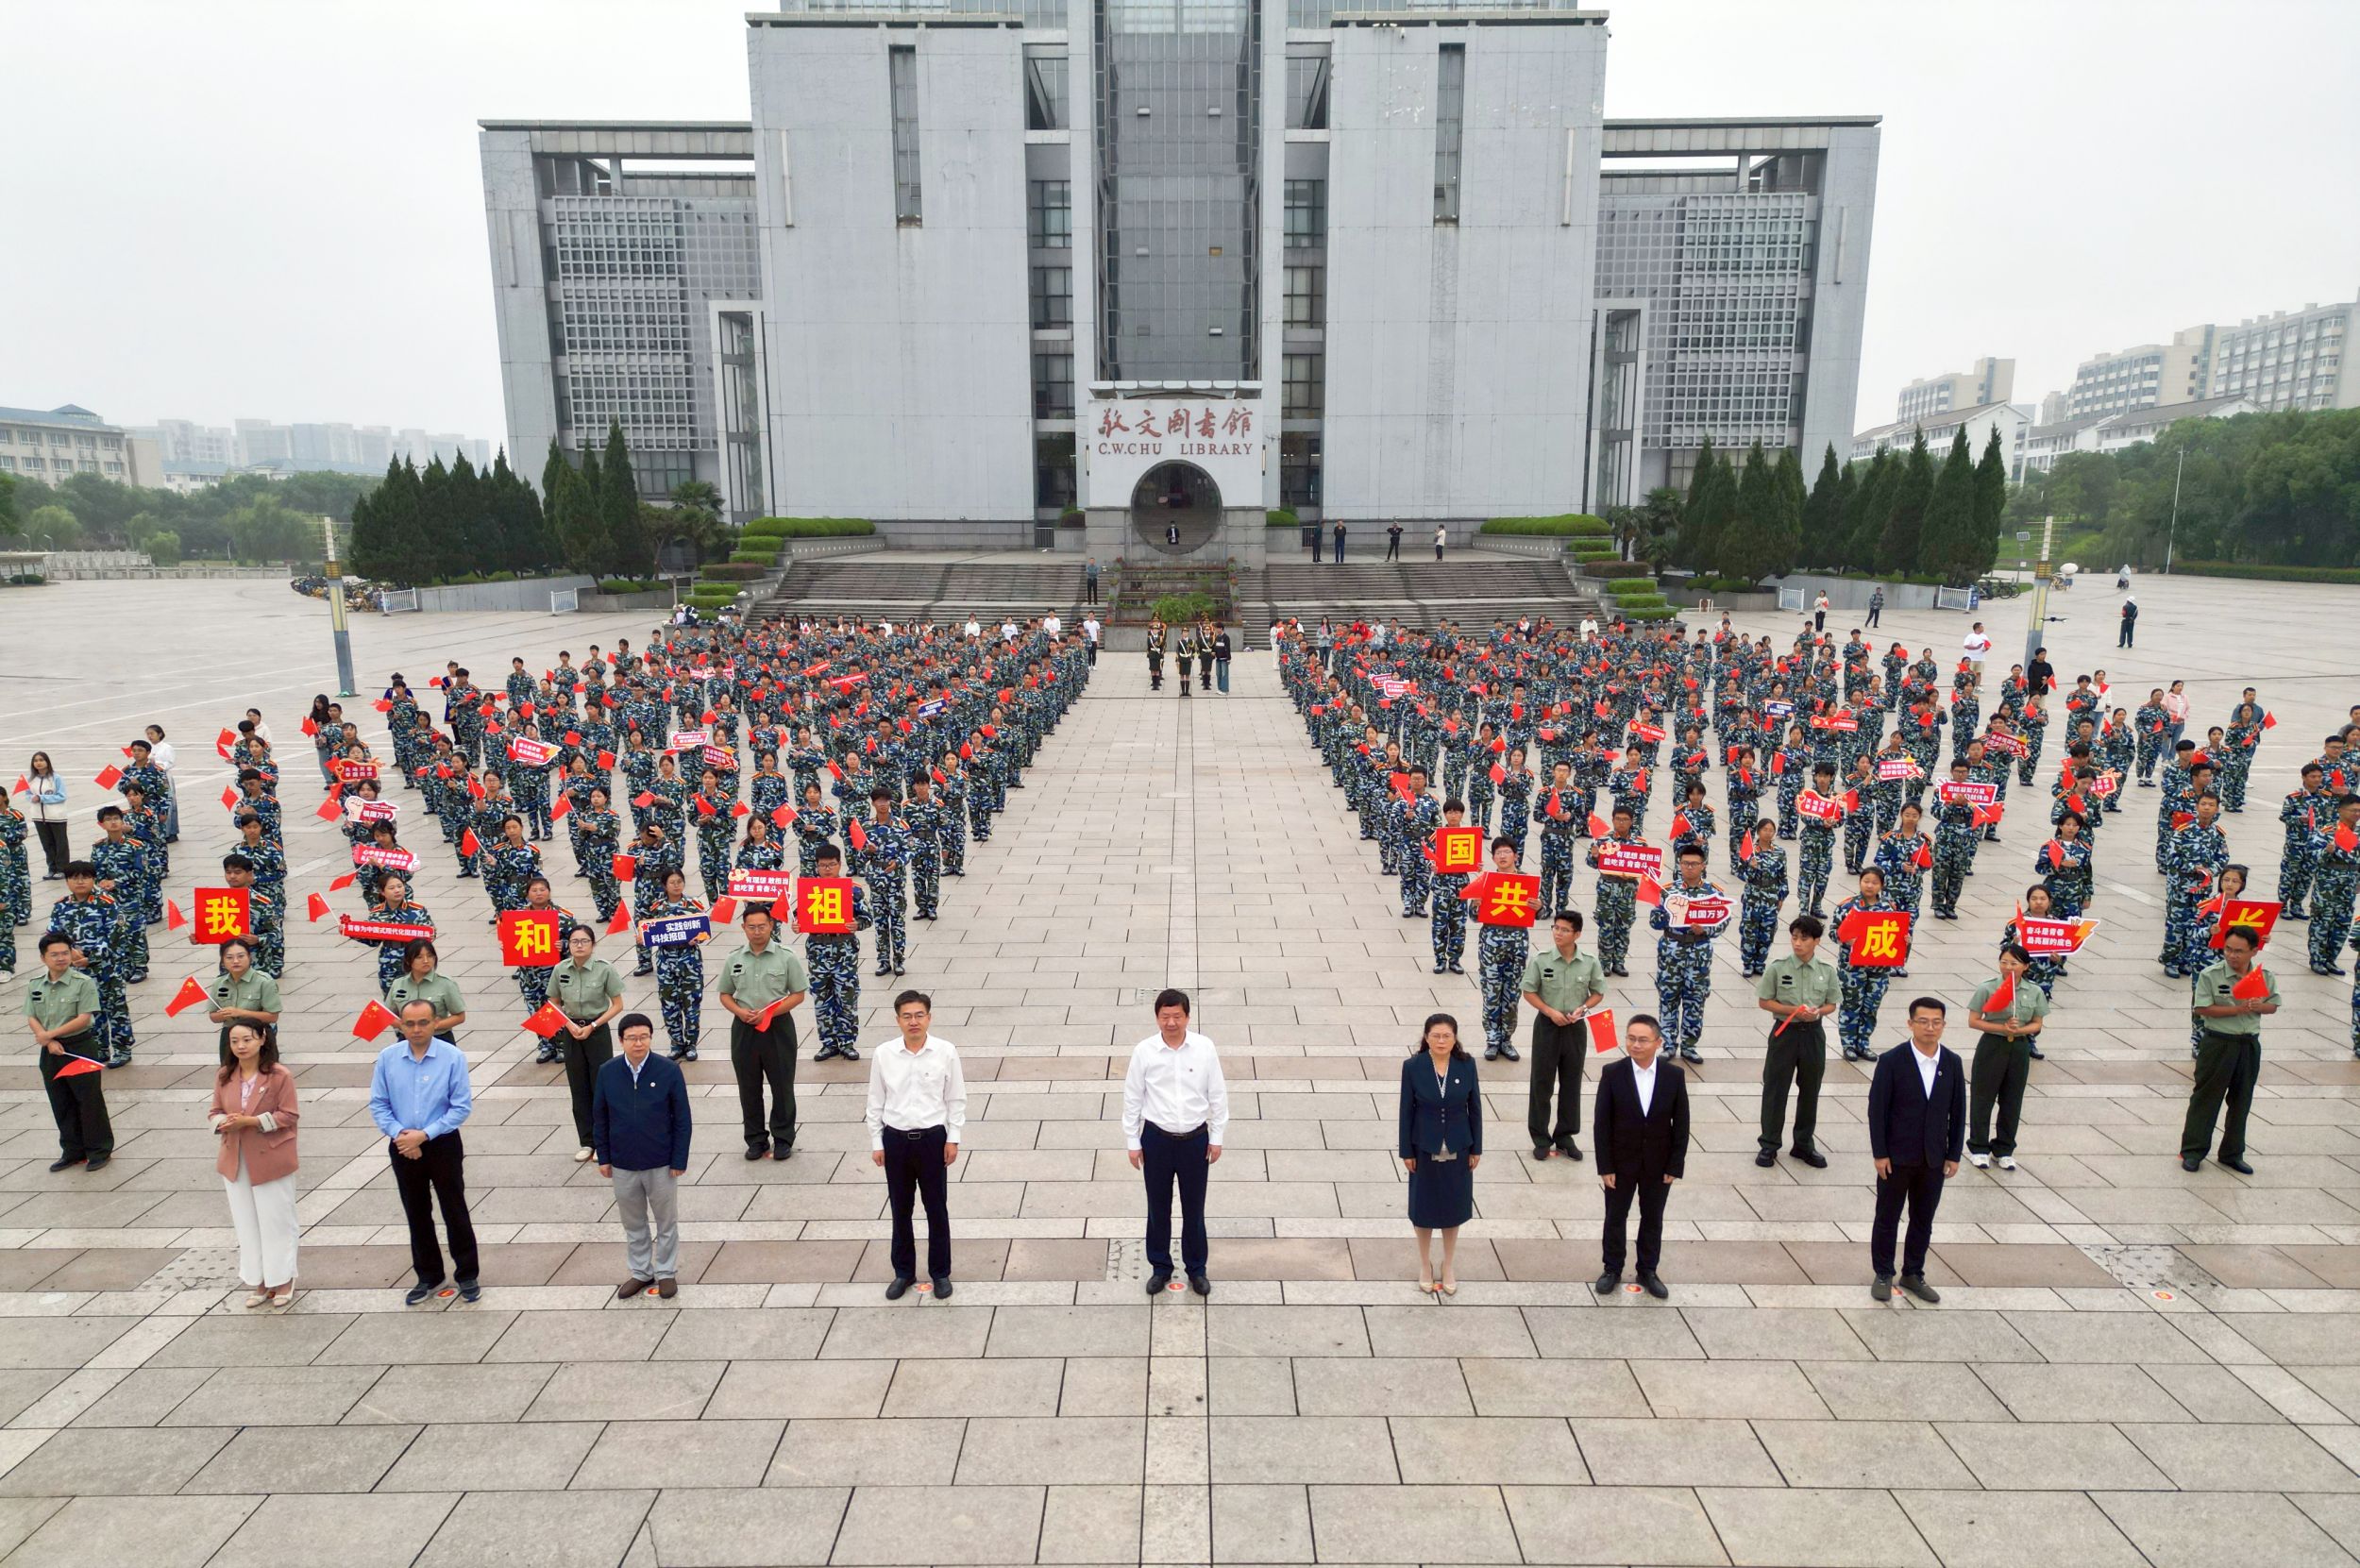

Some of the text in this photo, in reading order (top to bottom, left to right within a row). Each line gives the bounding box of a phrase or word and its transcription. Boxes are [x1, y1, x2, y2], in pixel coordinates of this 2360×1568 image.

[1098, 443, 1253, 454] C.W.CHU LIBRARY
[1446, 834, 1475, 866] 国
[1617, 851, 1660, 862] 有理想 敢担当
[1603, 857, 1648, 869] 能吃苦 肯奋斗
[745, 876, 789, 885] 有理想 敢担当
[733, 884, 778, 894] 能吃苦 肯奋斗
[807, 885, 845, 925] 祖
[1490, 881, 1528, 919] 共
[205, 896, 242, 936] 我
[1689, 910, 1725, 919] 祖国万岁
[666, 919, 701, 933] 实践创新
[2026, 927, 2065, 936] 奋斗是青春
[514, 919, 551, 958] 和
[650, 931, 687, 944] 科技报国
[1861, 919, 1900, 958] 成
[2026, 936, 2072, 947] 最亮丽的底色
